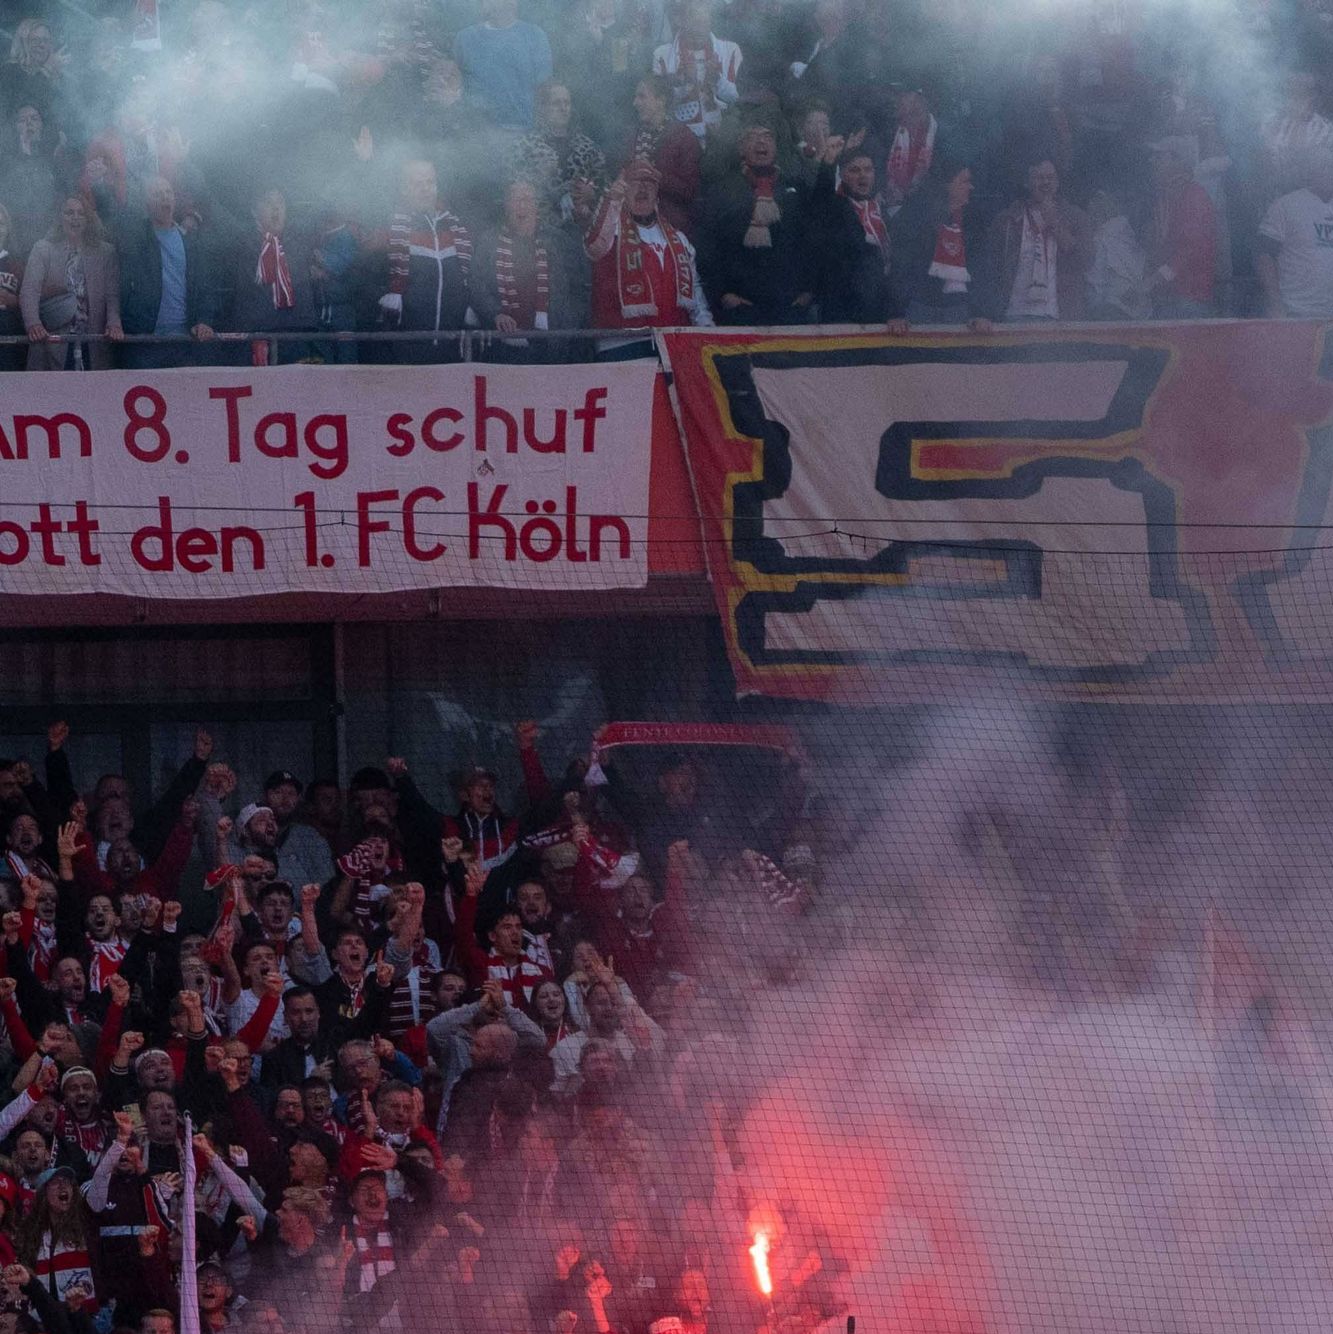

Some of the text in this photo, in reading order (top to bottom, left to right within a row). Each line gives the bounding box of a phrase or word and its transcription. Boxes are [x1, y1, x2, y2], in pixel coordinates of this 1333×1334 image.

[123, 385, 190, 465] 8.
[208, 385, 349, 480] Tag
[386, 375, 608, 458] schuf
[131, 496, 266, 573] den
[467, 481, 631, 563] Köln
